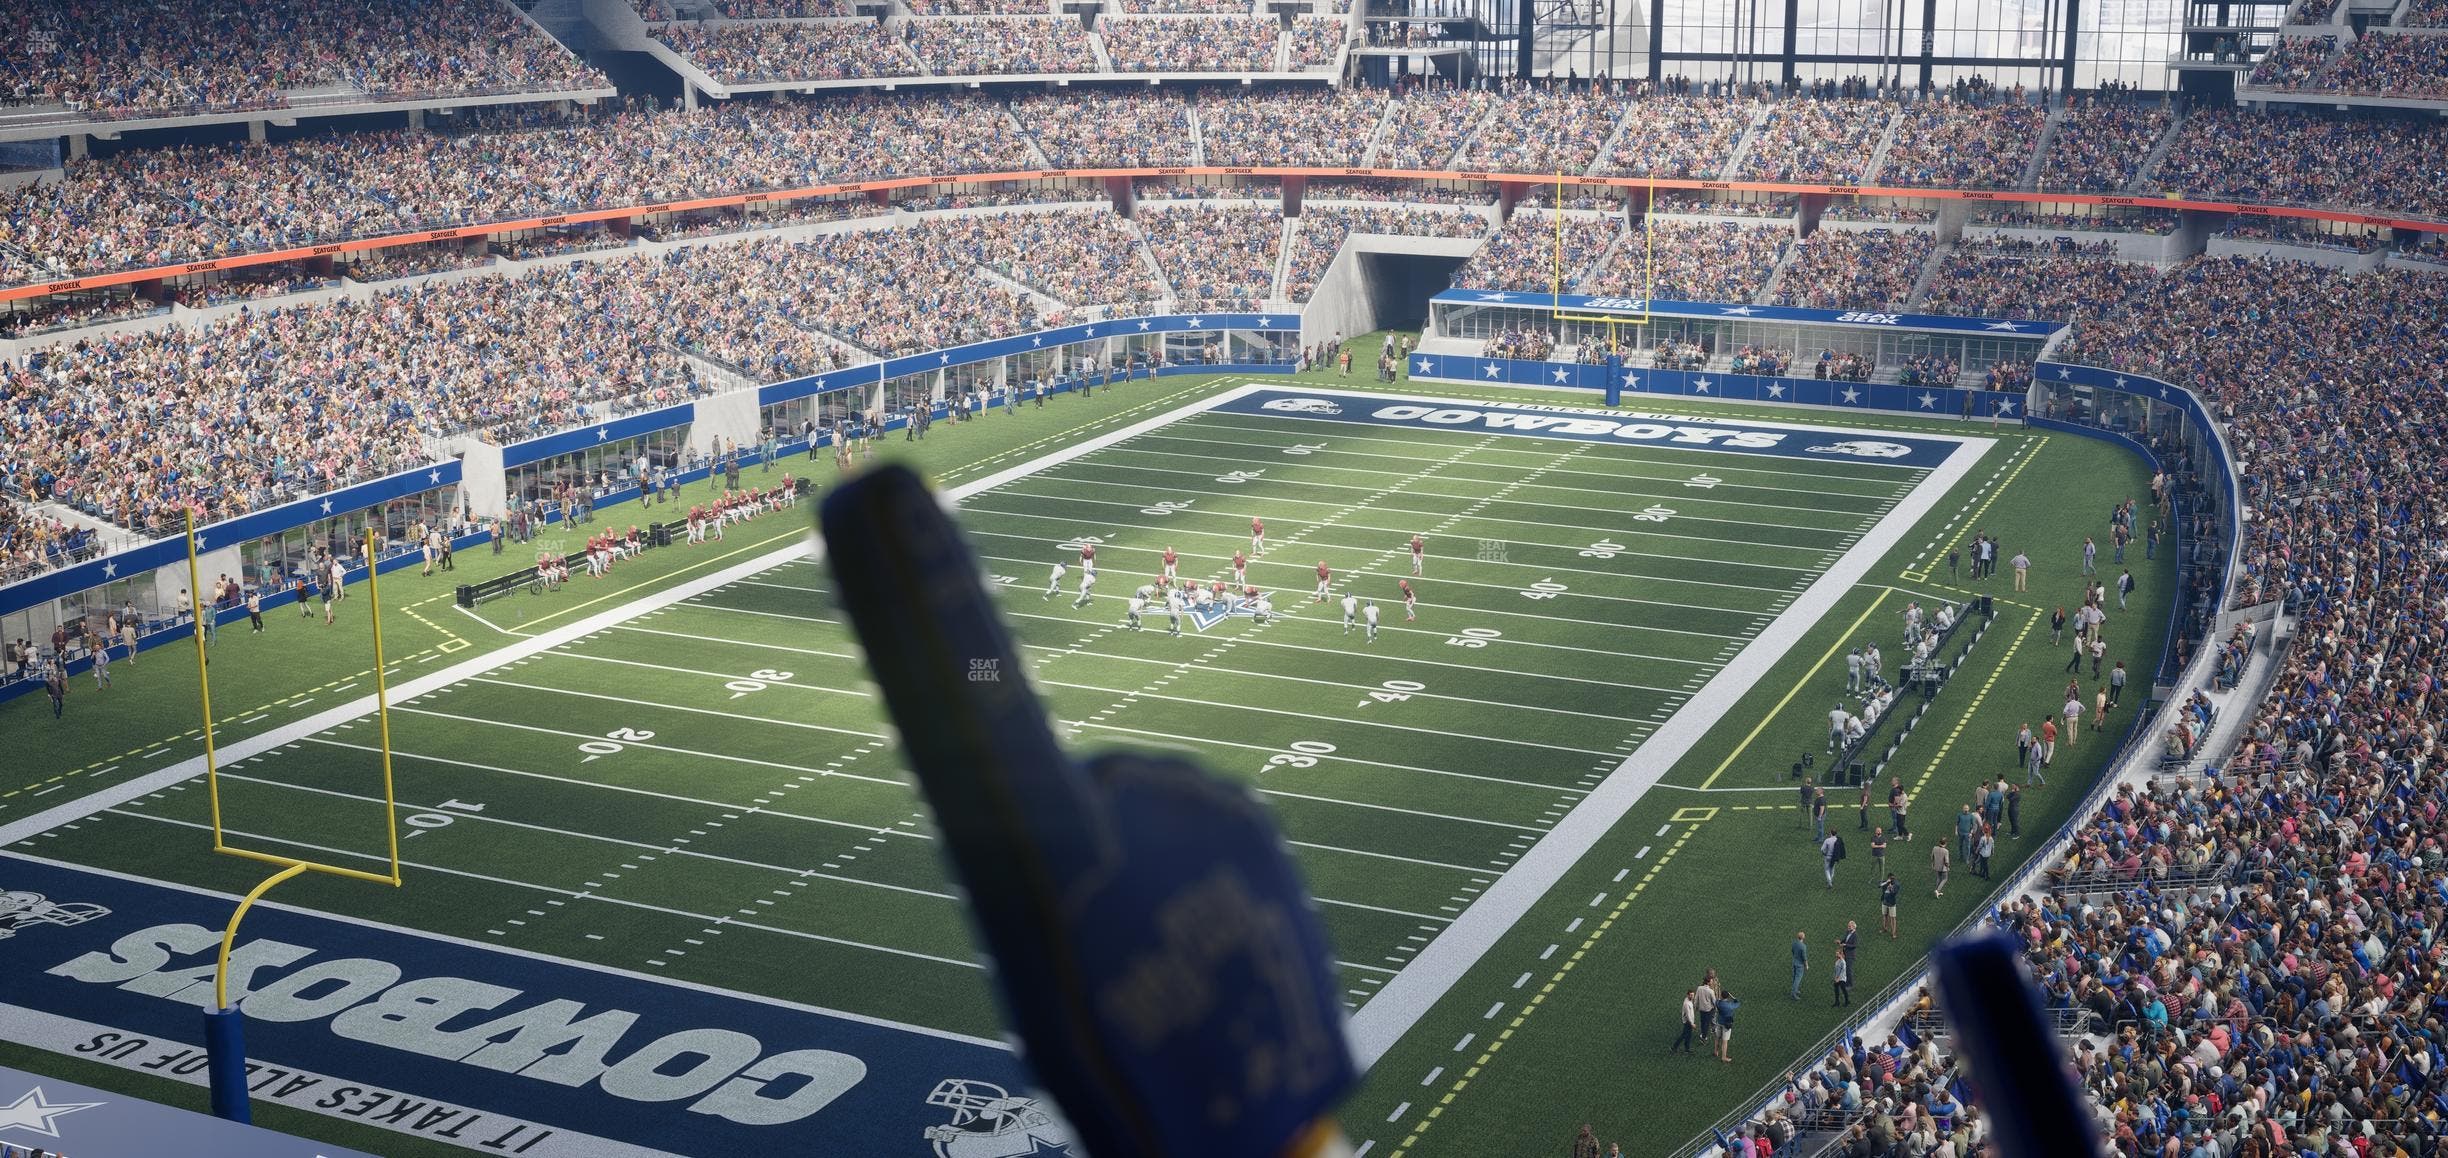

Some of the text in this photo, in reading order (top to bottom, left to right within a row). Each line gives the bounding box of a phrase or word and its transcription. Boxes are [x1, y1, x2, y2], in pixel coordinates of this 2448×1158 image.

[1828, 186, 1860, 194] SEATGEEK
[1962, 192, 1994, 200] SEATGEEK
[2101, 197, 2135, 205] SEATGEEK
[646, 204, 670, 214] SEATGEEK
[2236, 205, 2269, 214] SEATGEEK
[541, 216, 567, 226] SEATGEEK
[2364, 216, 2393, 227] SEATGEEK
[430, 230, 458, 240] SEATGEEK
[313, 244, 342, 256] SEATGEEK
[186, 261, 217, 273] SEATGEEK
[48, 280, 82, 293] SEATGEEK
[1371, 406, 1787, 448] COWBOYS
[1282, 444, 1321, 455] 10
[1215, 470, 1261, 484] 20
[1683, 476, 1722, 489] 10
[1140, 501, 1189, 516] 30
[1632, 508, 1678, 522] 20
[1578, 543, 1626, 559] 30
[1519, 582, 1568, 600] 40
[1444, 628, 1502, 648] 50
[724, 668, 794, 692] 30
[1368, 680, 1426, 703] 40
[578, 727, 656, 754] 20
[1269, 741, 1337, 768] 30
[404, 798, 486, 828] 10
[44, 923, 867, 1125] COWBOYS
[74, 1032, 149, 1061] US
[140, 1050, 210, 1075] OF
[315, 1086, 482, 1139] TAKES
[480, 1124, 553, 1154] IT
